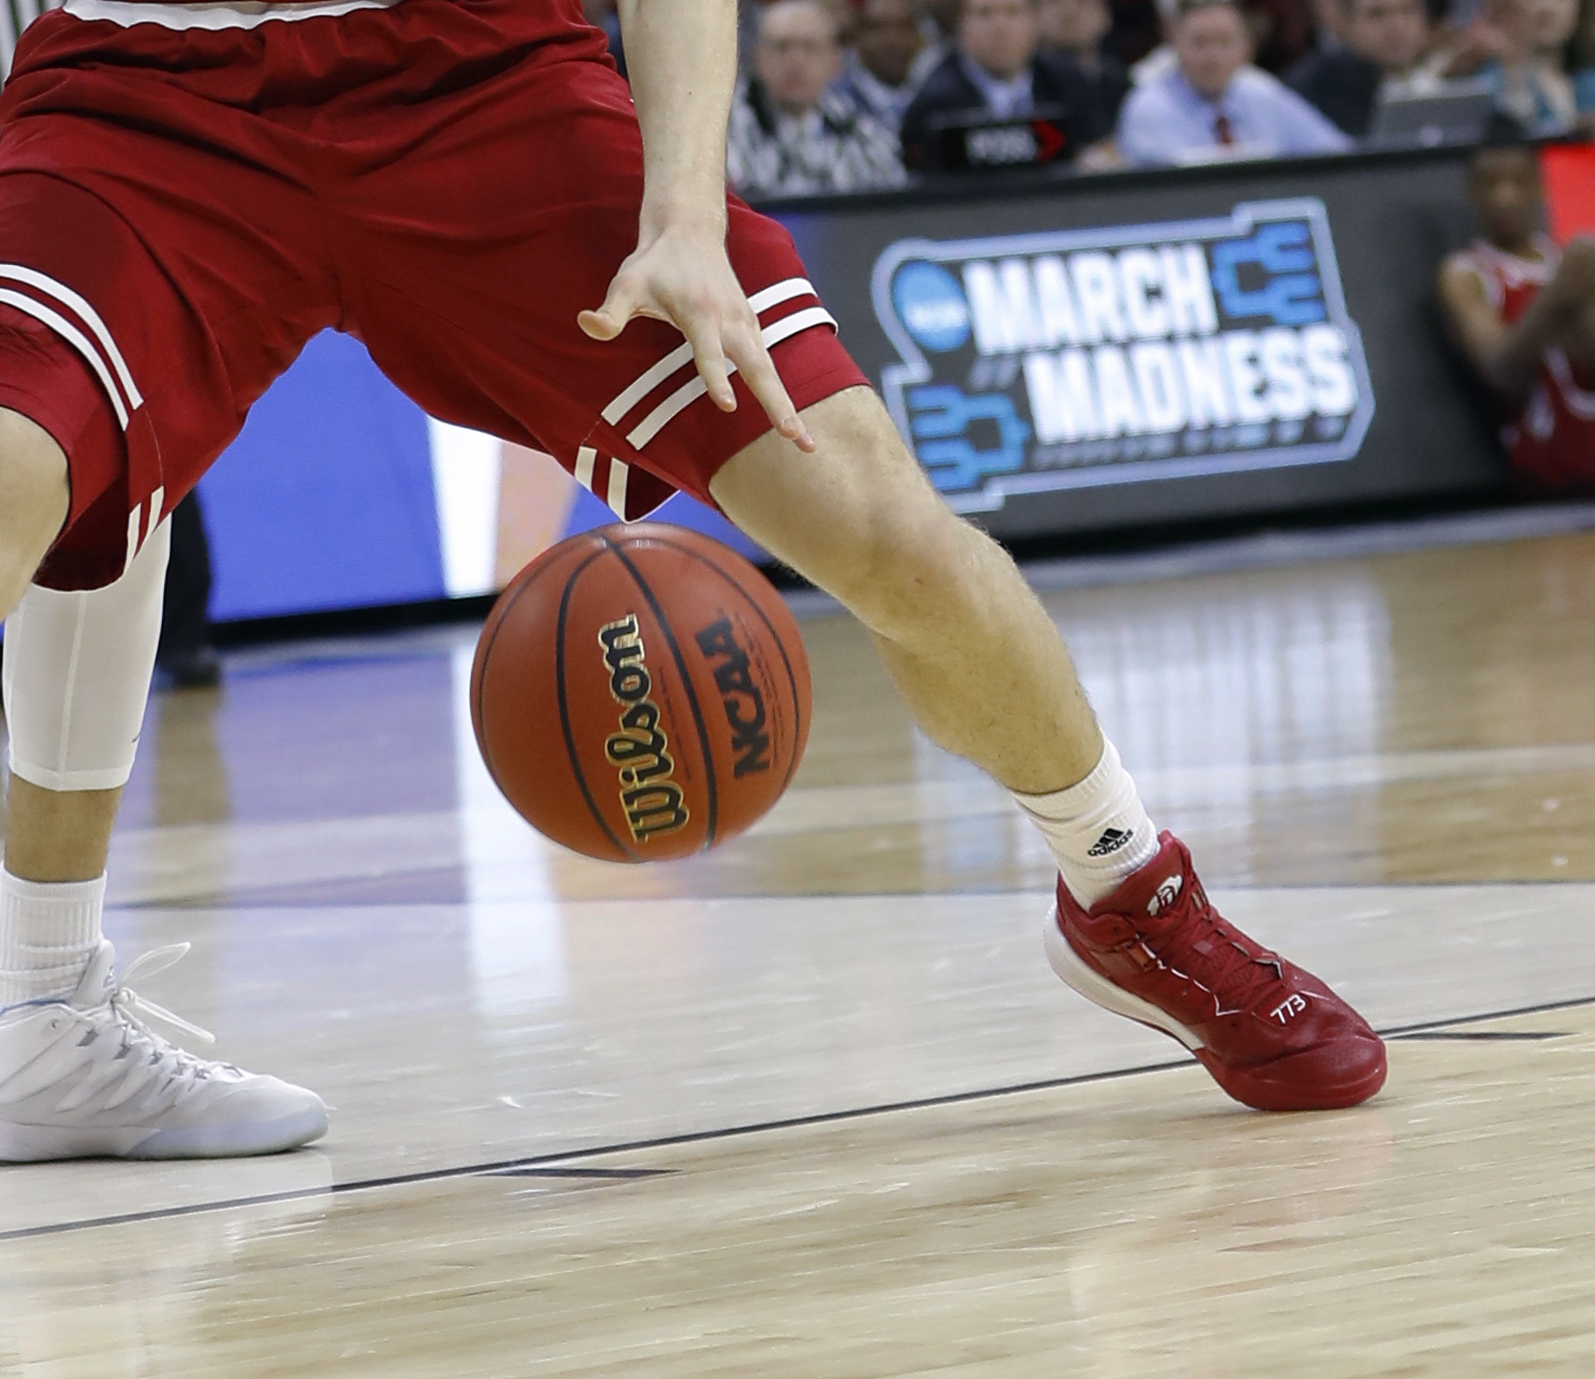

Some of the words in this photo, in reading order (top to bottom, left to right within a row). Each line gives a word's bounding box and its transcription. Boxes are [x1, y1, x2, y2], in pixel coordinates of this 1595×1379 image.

[962, 243, 1219, 356] MARCH
[1024, 323, 1359, 445] MADNESS
[598, 612, 689, 843] Wilson
[695, 617, 770, 779] NCAA
[1087, 829, 1134, 857] adidas
[1270, 994, 1307, 1025] 773
